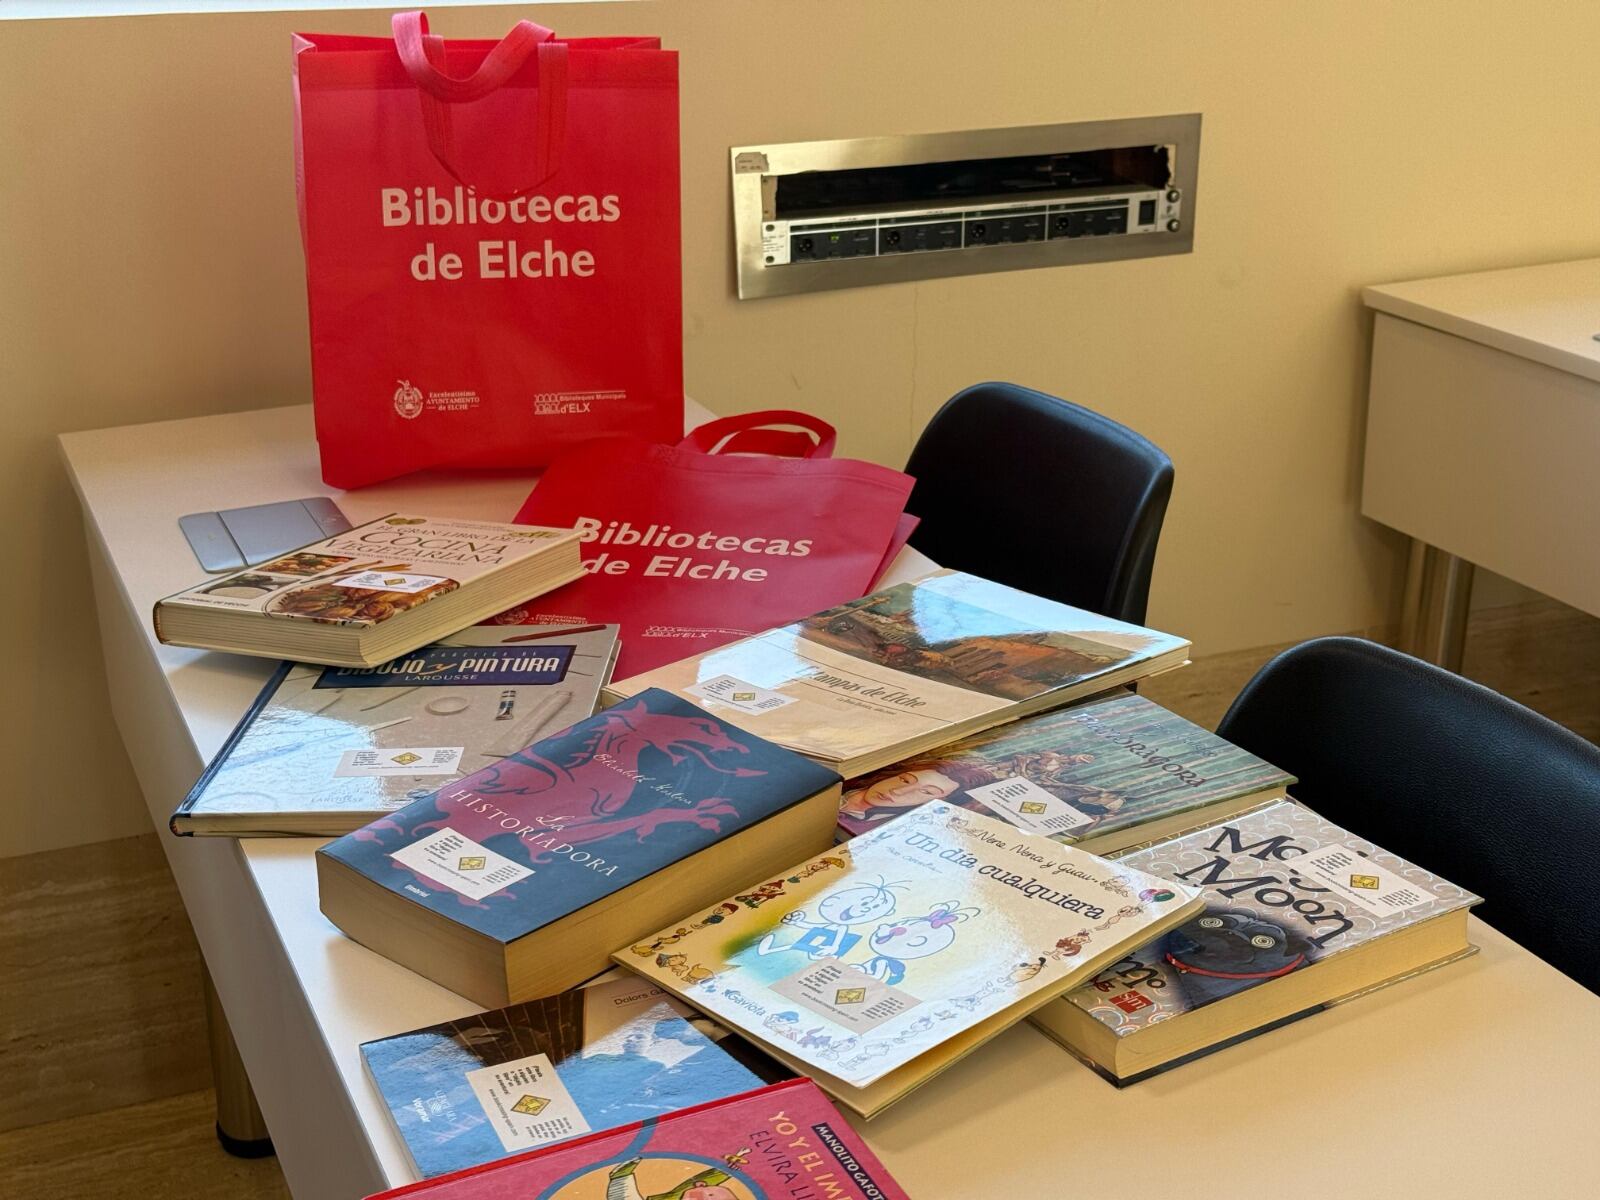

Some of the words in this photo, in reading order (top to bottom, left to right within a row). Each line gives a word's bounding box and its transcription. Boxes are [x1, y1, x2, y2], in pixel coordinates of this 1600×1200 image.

[382, 186, 620, 226] Bibliotecas
[411, 243, 463, 280] de
[478, 240, 595, 279] Elche
[560, 402, 590, 414] d'ELX
[360, 532, 508, 555] COCINA
[574, 516, 812, 557] Bibliotecas
[324, 538, 503, 564] VEGETARIANA
[583, 554, 630, 575] de
[644, 556, 768, 582] Elche
[458, 658, 560, 672] PINTURA
[860, 686, 885, 697] de
[880, 692, 926, 708] Elche
[450, 789, 618, 876] HISTORIADORA
[536, 814, 575, 832] La
[905, 832, 940, 854] Un
[939, 848, 978, 870] día
[978, 865, 1104, 920] cualquiera
[1173, 855, 1354, 950] Moon
[768, 1110, 798, 1136] YO
[788, 1136, 810, 1148] Y
[816, 1126, 860, 1172] MANOLITO
[749, 1130, 798, 1184] ELVIRA
[798, 1152, 824, 1172] EL
[814, 1172, 853, 1200] IM
